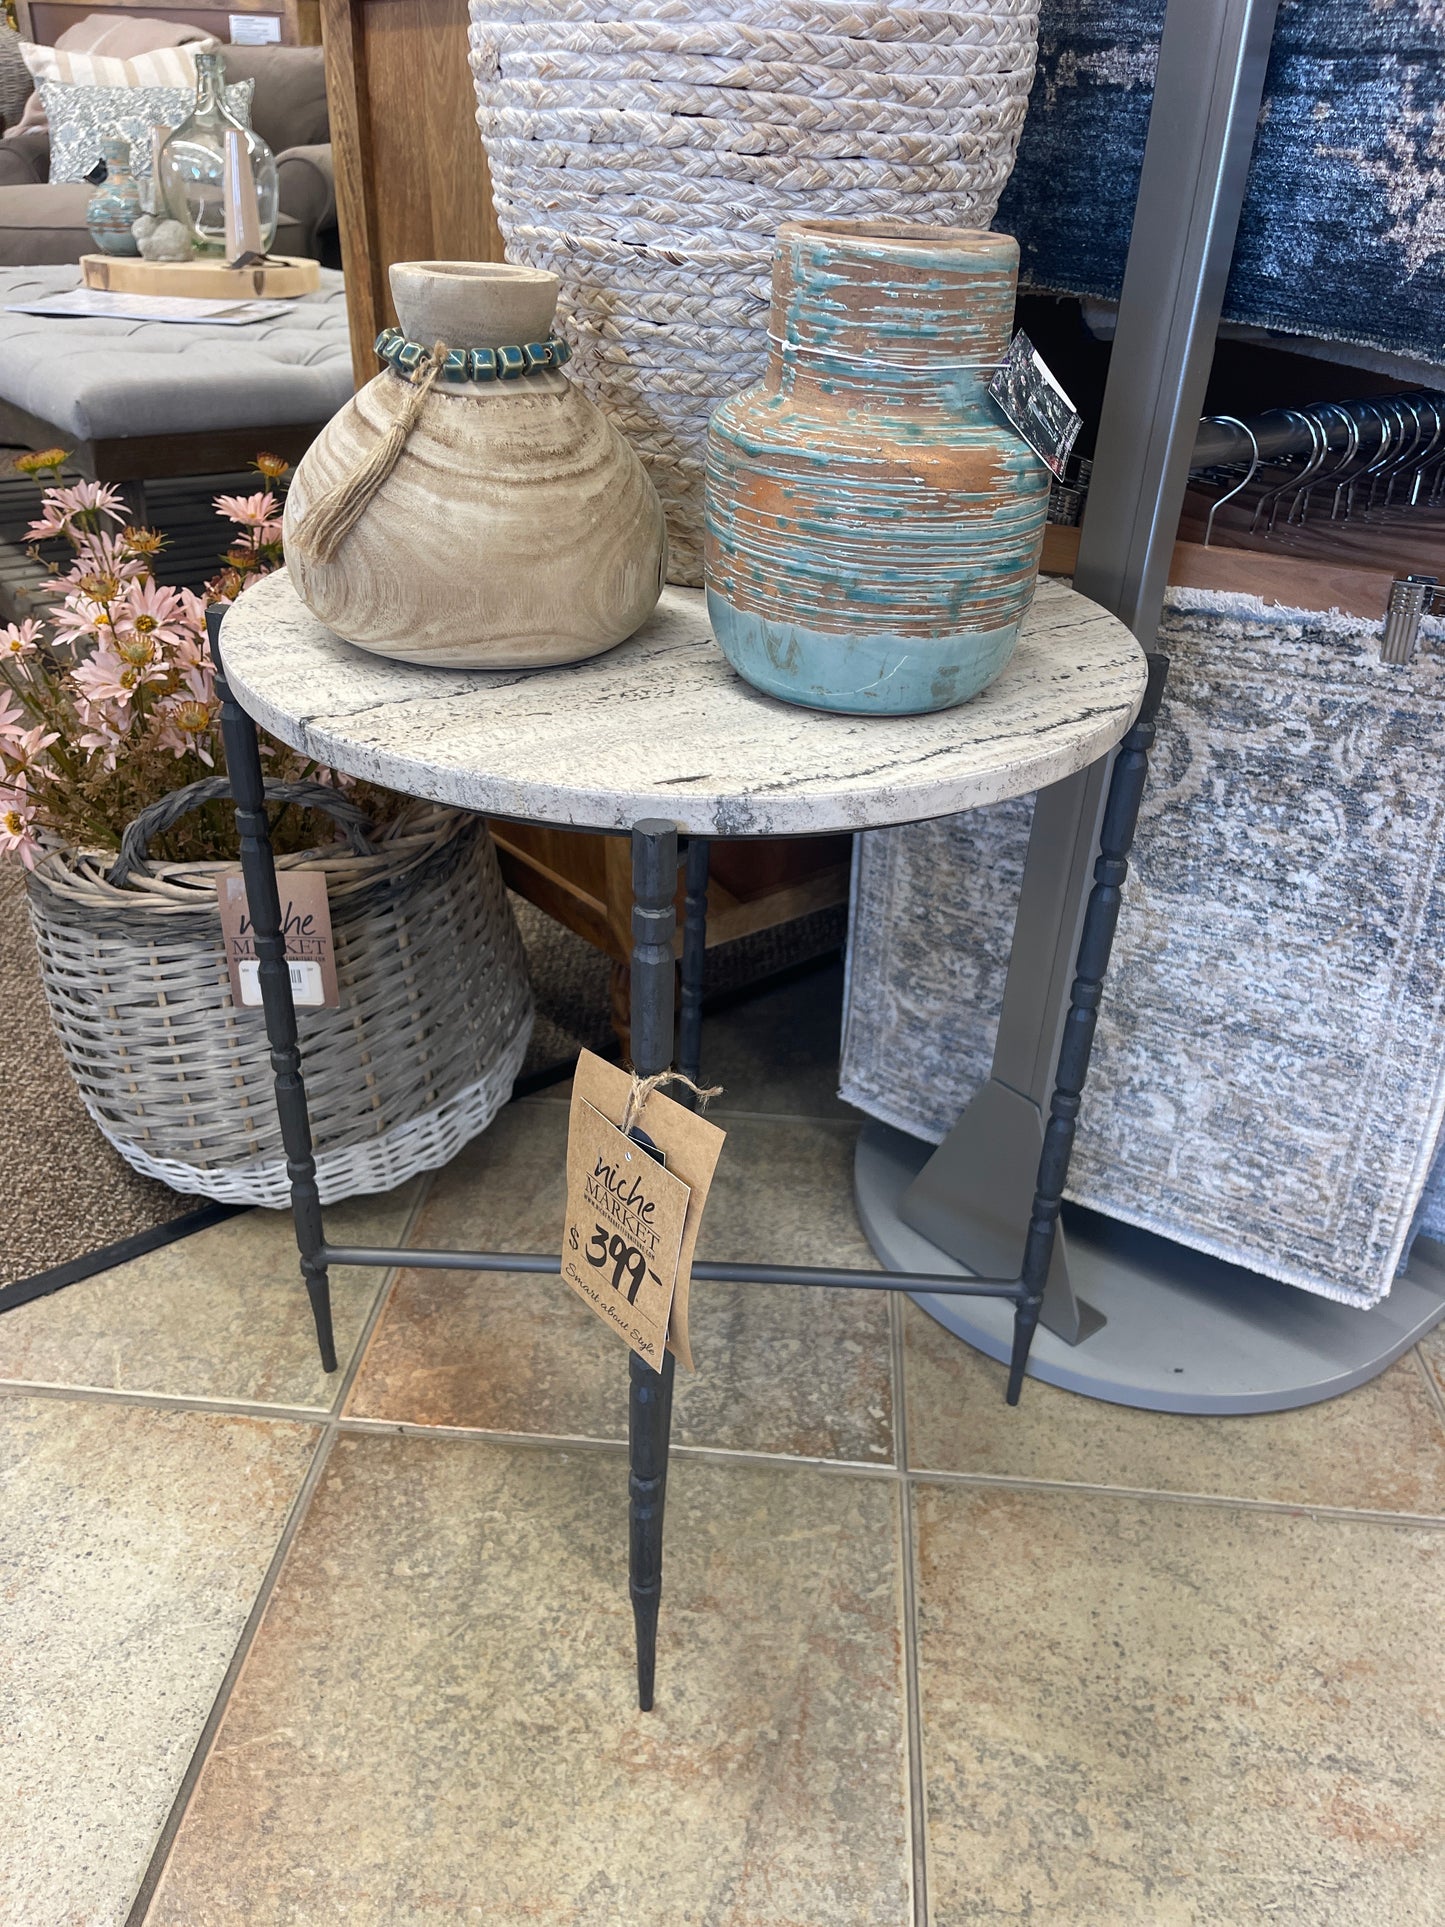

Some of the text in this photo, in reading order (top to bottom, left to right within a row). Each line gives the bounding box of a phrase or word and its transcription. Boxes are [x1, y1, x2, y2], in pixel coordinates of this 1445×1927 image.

[232, 939, 326, 955] MKET
[240, 901, 316, 935] nhe
[585, 1177, 660, 1250] MARKET
[594, 1157, 655, 1224] niche
[566, 1263, 655, 1356] Smart about Style
